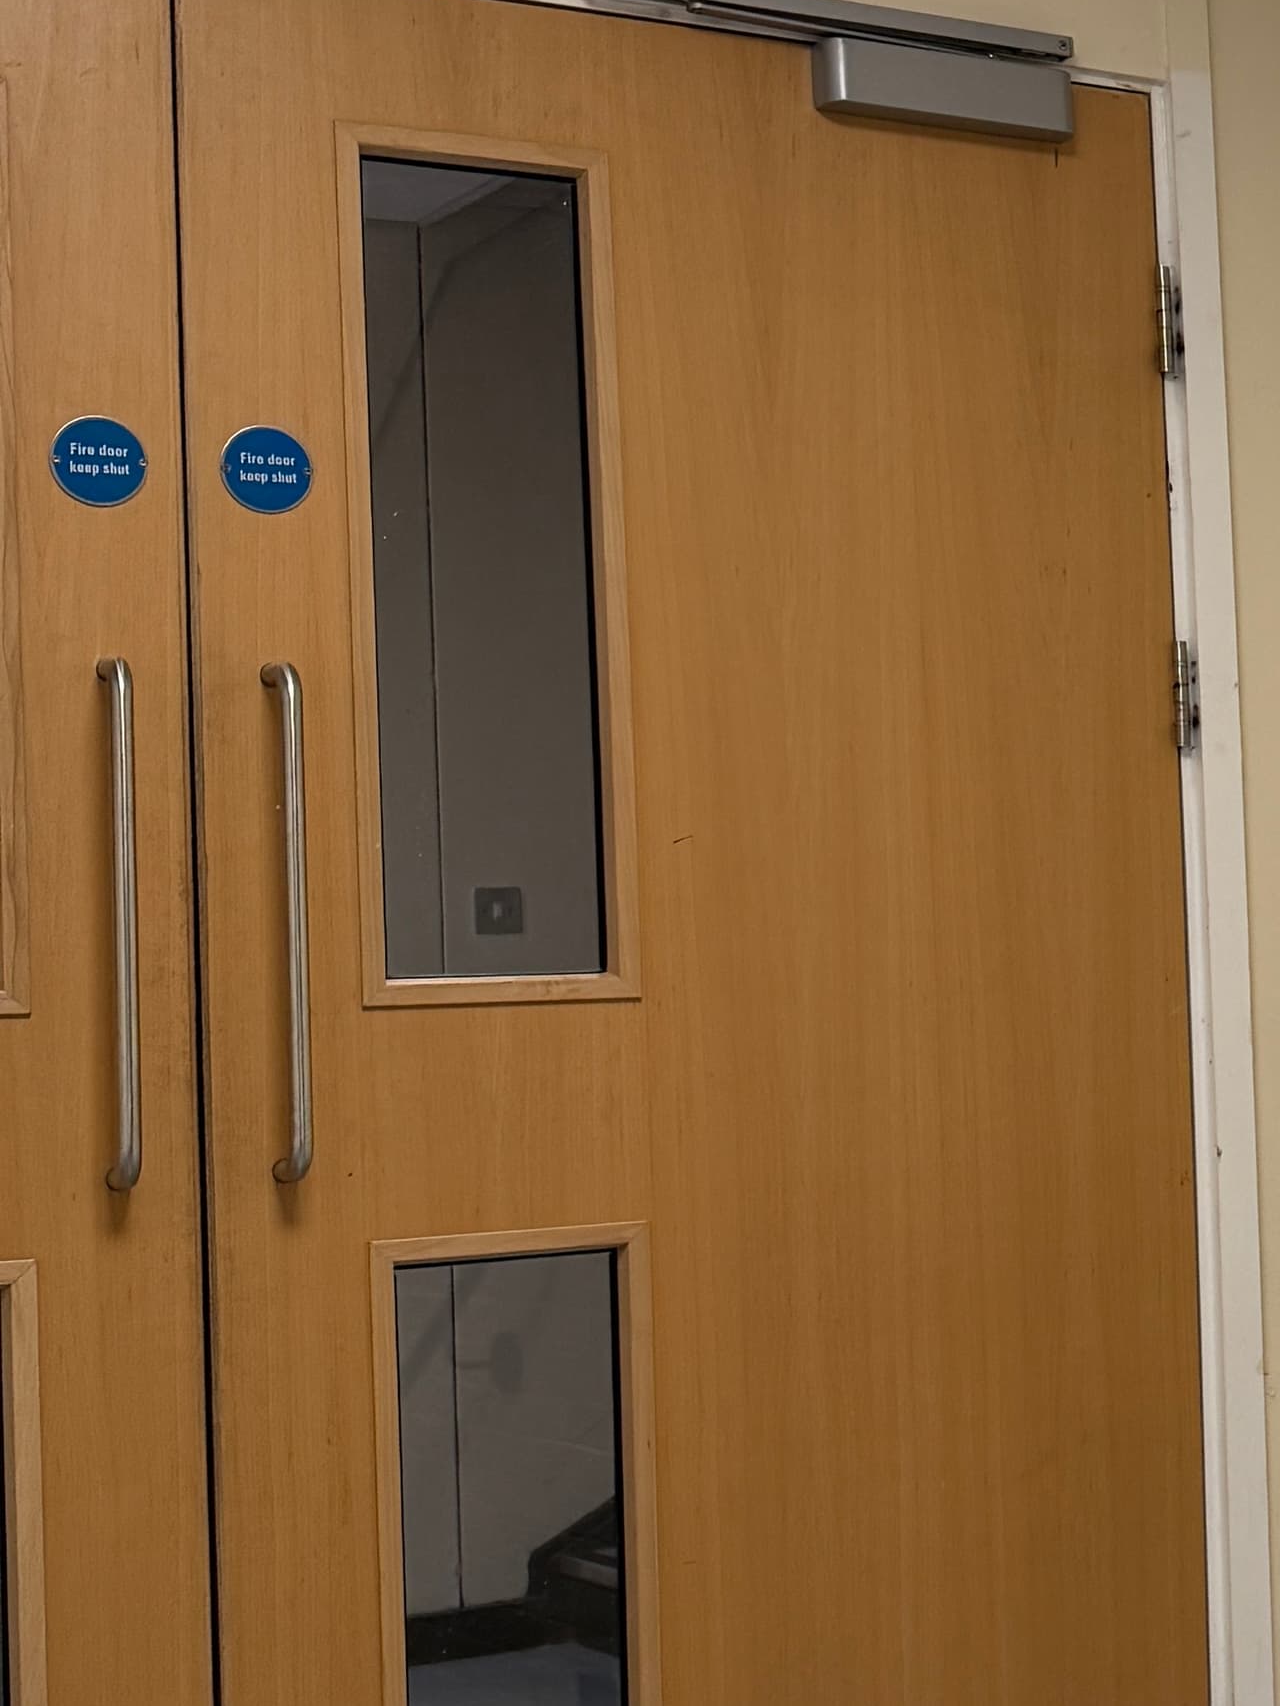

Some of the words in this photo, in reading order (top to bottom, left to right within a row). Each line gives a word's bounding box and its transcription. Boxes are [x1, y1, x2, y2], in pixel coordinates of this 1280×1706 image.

[70, 442, 95, 456] Fire
[99, 444, 128, 457] door
[240, 452, 264, 465] Fire
[267, 454, 295, 466] door
[69, 460, 100, 476] keep
[103, 462, 130, 475] shut
[239, 470, 269, 484] keep
[271, 472, 297, 483] shut
